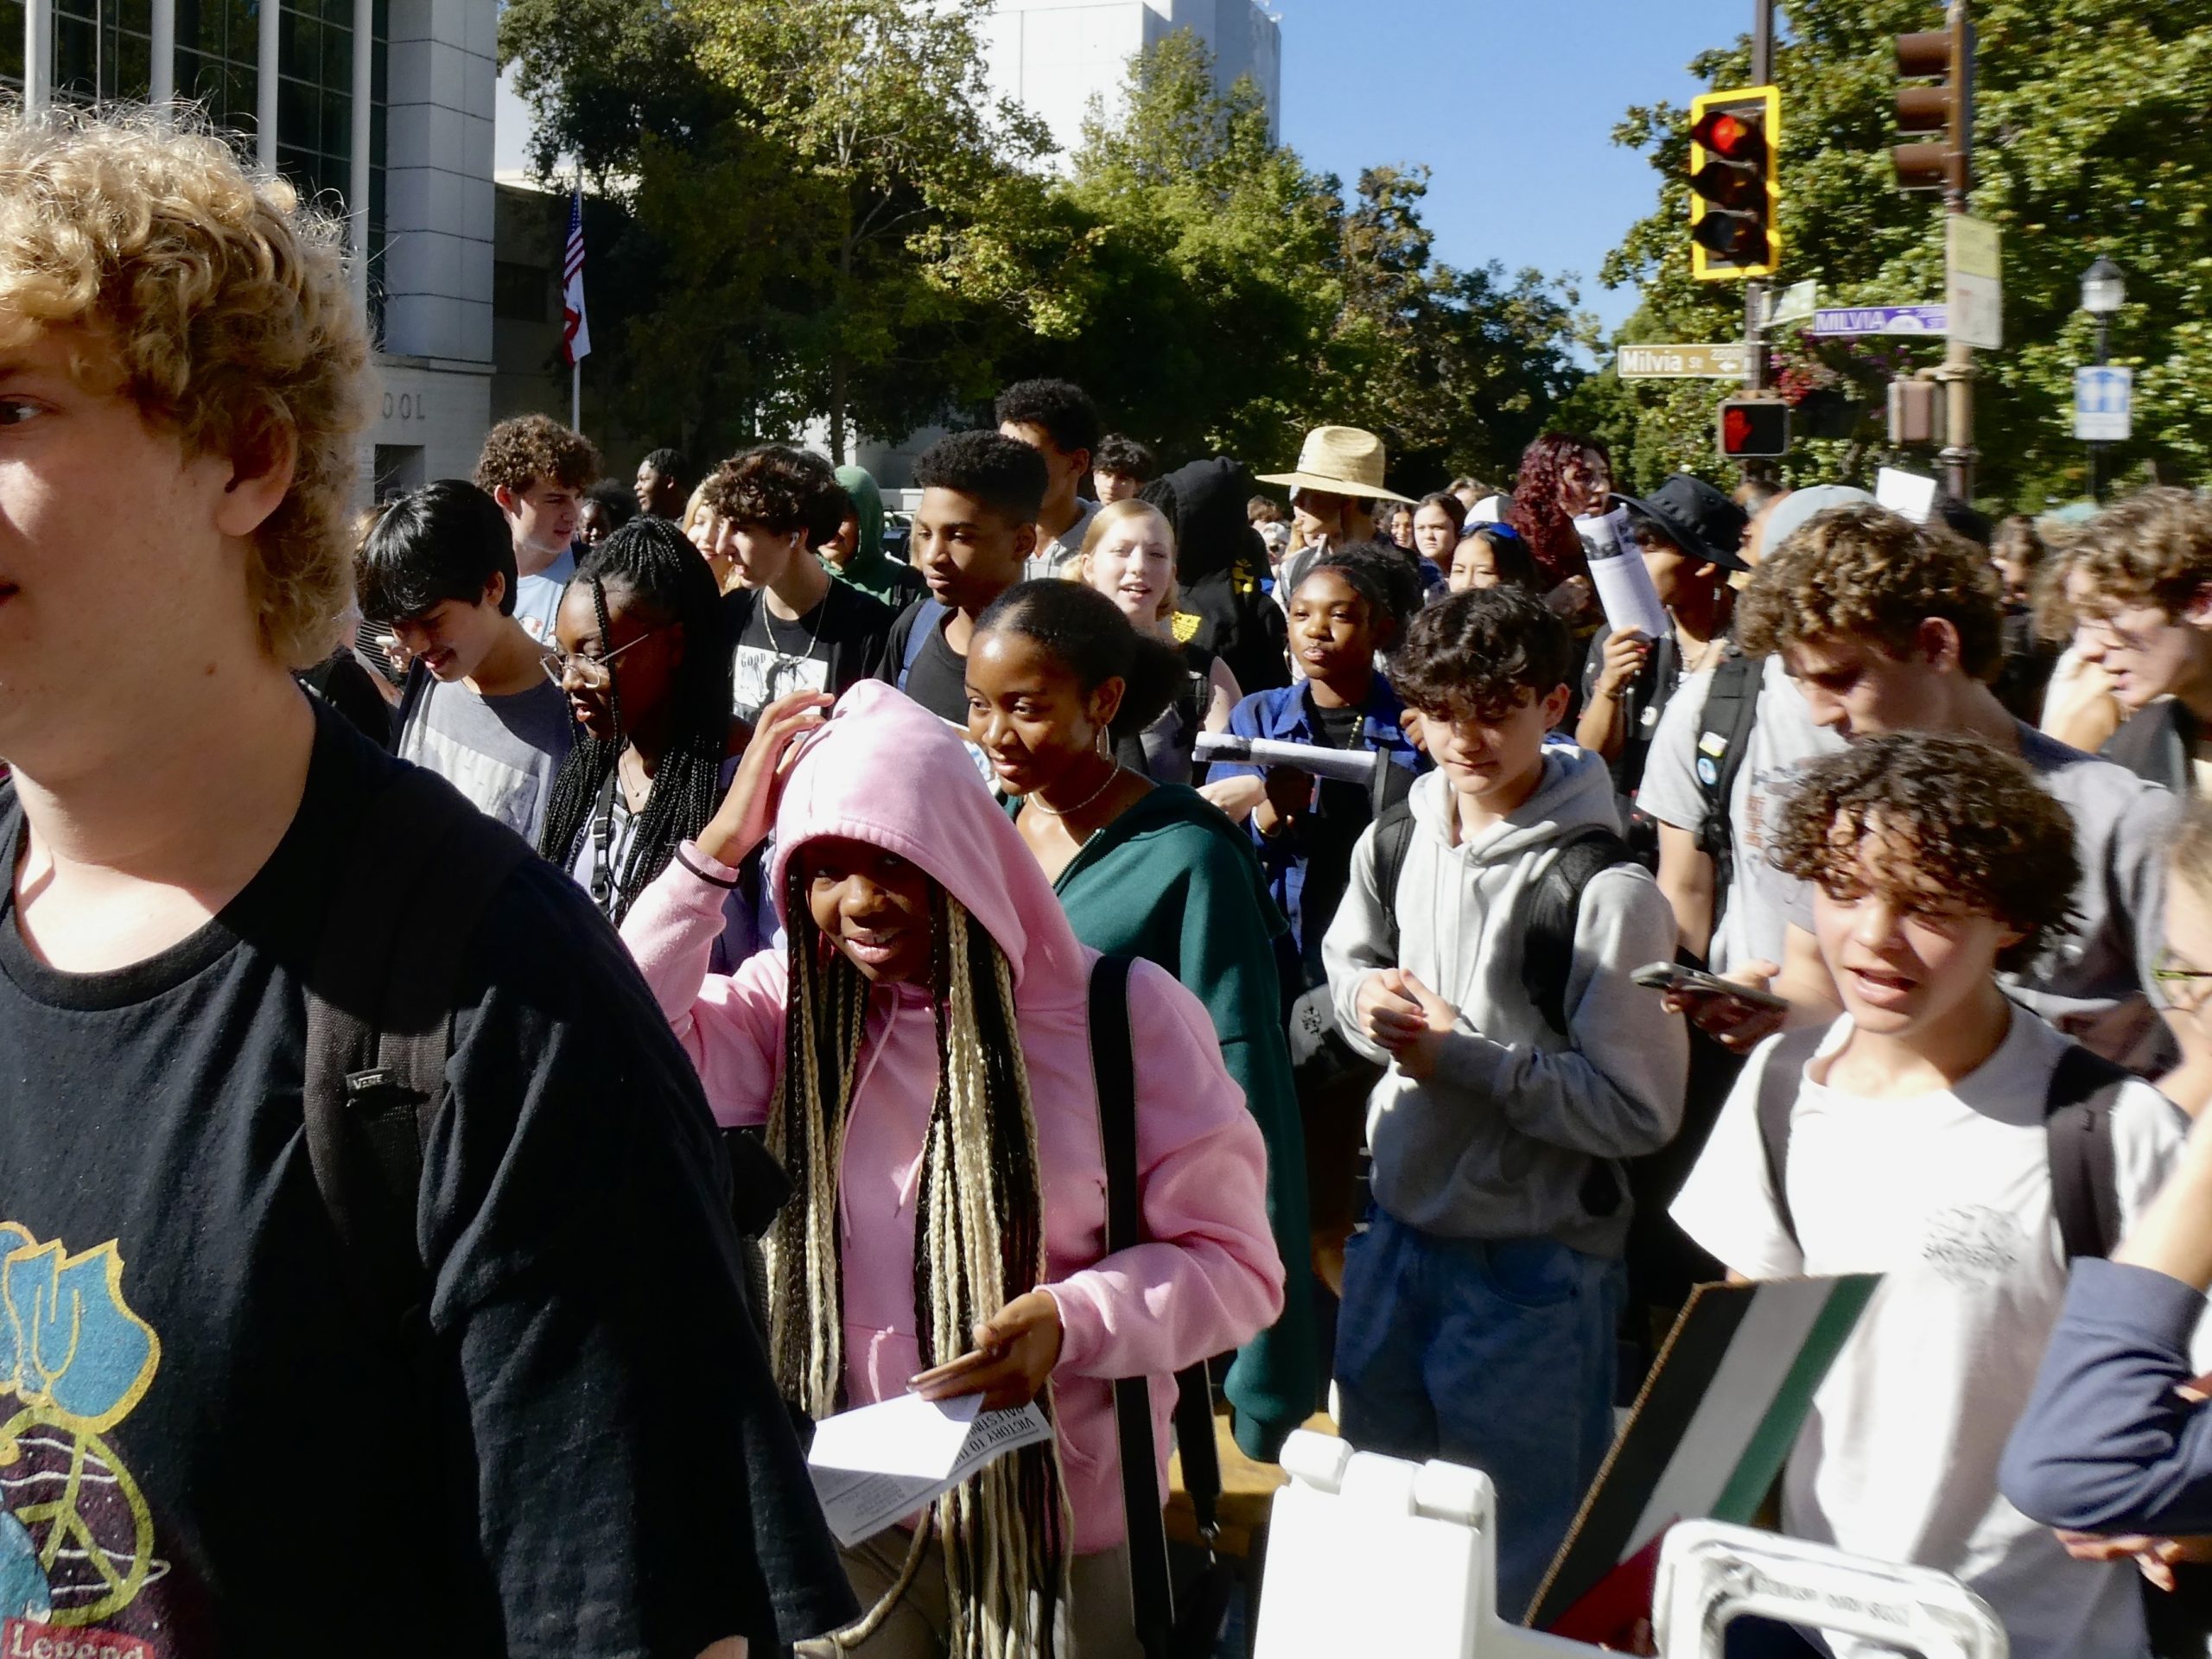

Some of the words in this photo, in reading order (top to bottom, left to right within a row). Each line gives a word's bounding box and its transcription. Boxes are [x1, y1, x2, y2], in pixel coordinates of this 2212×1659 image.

[1816, 311, 1887, 332] MILVIA
[1623, 349, 1683, 372] Milvia
[382, 392, 425, 420] OOL
[741, 653, 766, 668] GOOD
[969, 1406, 1025, 1439] PALESTIN
[987, 1416, 1036, 1444] VICTORY
[969, 1438, 986, 1452] TO
